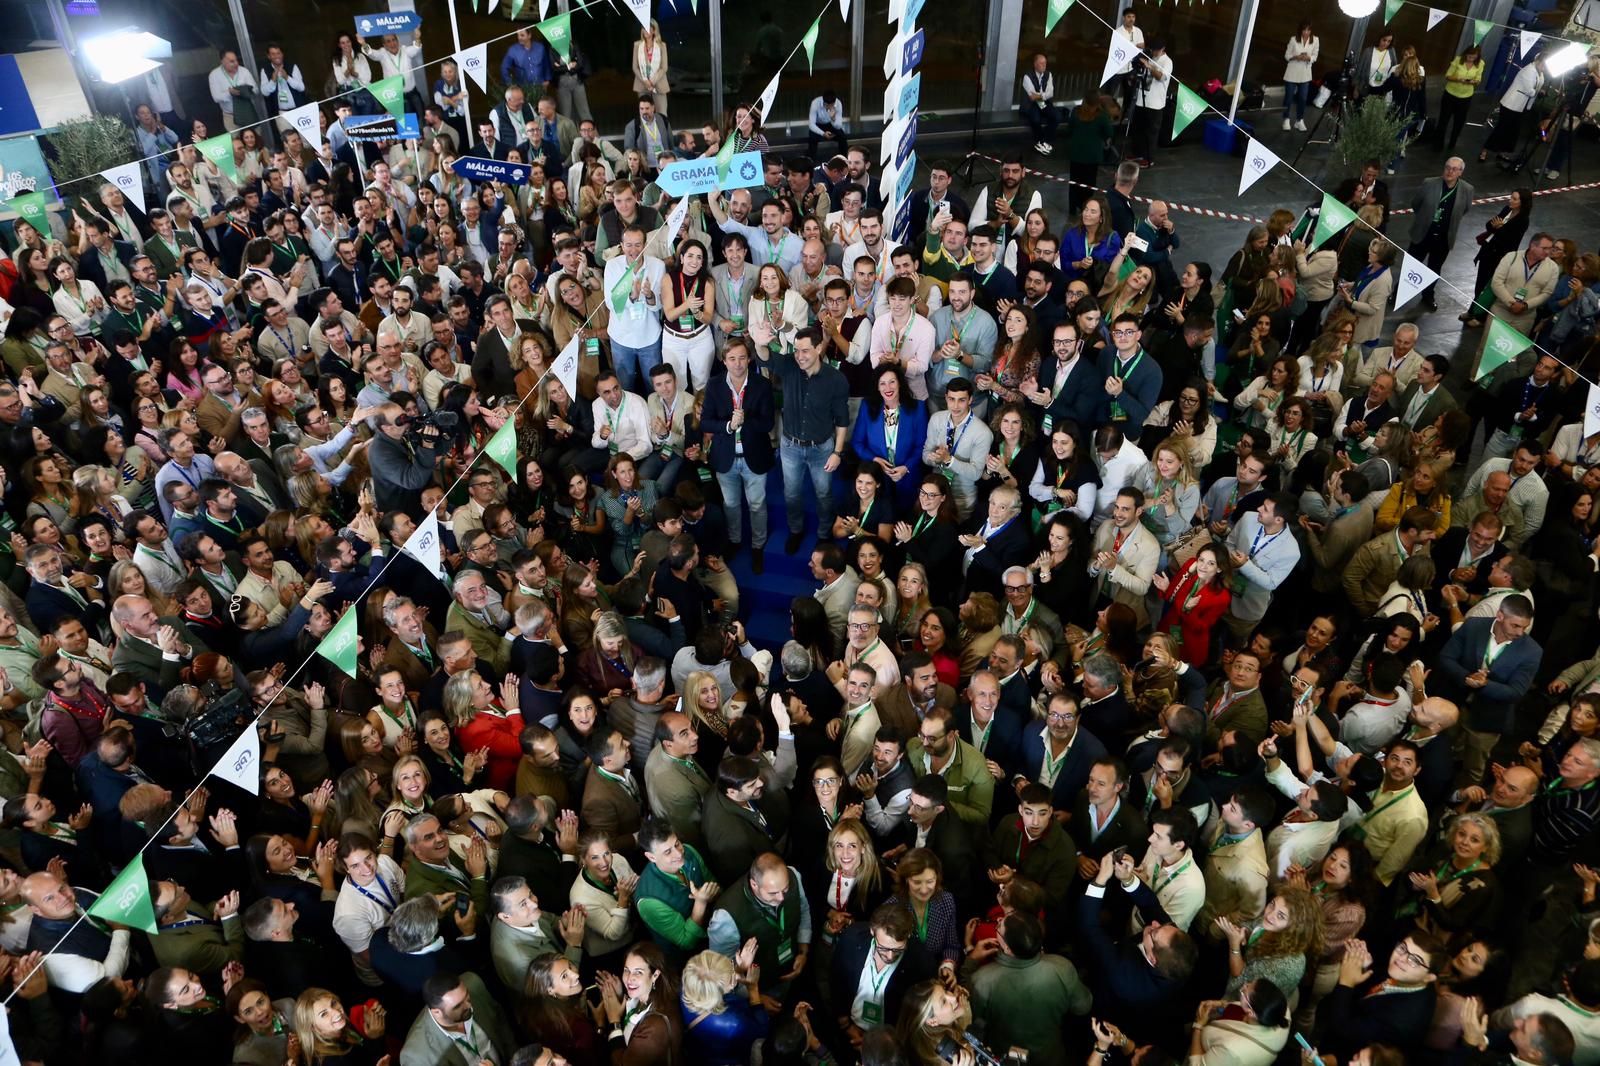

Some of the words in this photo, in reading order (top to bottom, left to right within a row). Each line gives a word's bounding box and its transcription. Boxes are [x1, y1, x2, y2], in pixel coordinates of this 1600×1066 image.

[376, 15, 411, 27] MÁLAGA
[465, 162, 506, 174] MÁLAGA
[671, 165, 733, 182] GRANA
